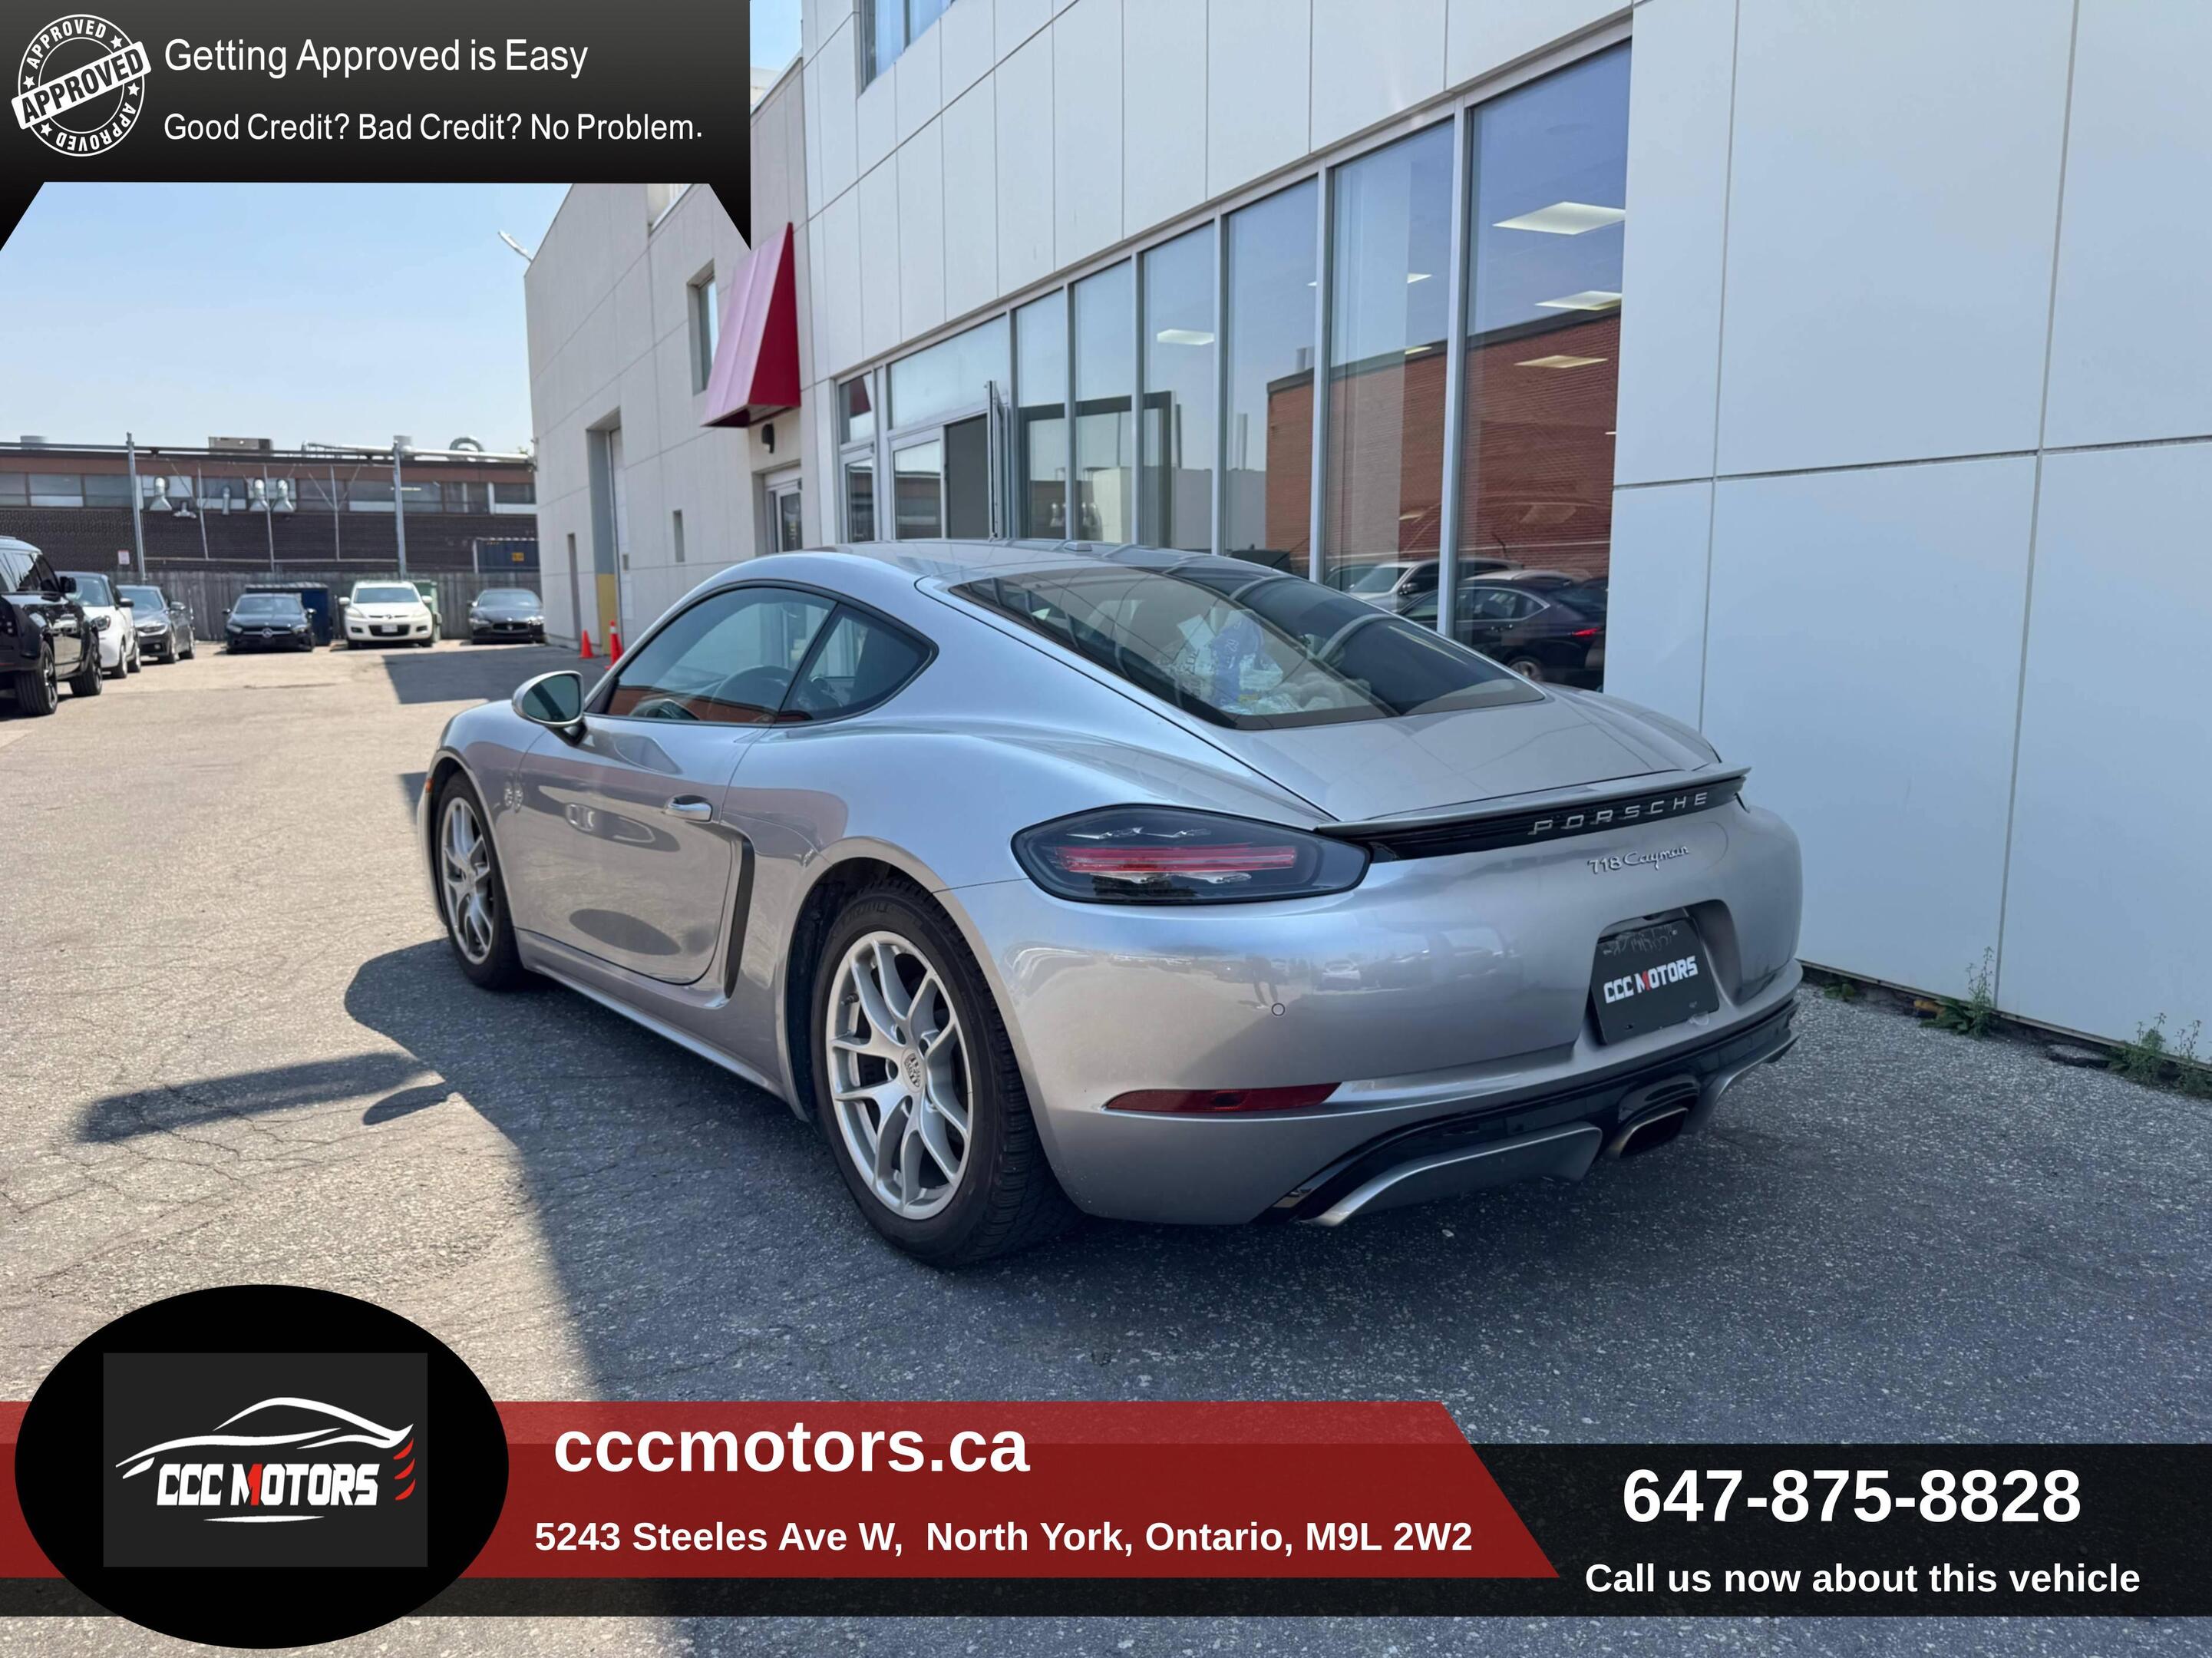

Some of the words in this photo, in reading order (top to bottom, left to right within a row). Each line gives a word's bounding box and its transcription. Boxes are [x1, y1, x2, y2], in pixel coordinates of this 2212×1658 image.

[1529, 791, 1709, 835] PORSCHE
[1587, 856, 1623, 874] 718
[1623, 845, 1690, 870] Cayman
[1603, 975, 1635, 1004] CCC
[1633, 955, 1699, 993] MOTORS
